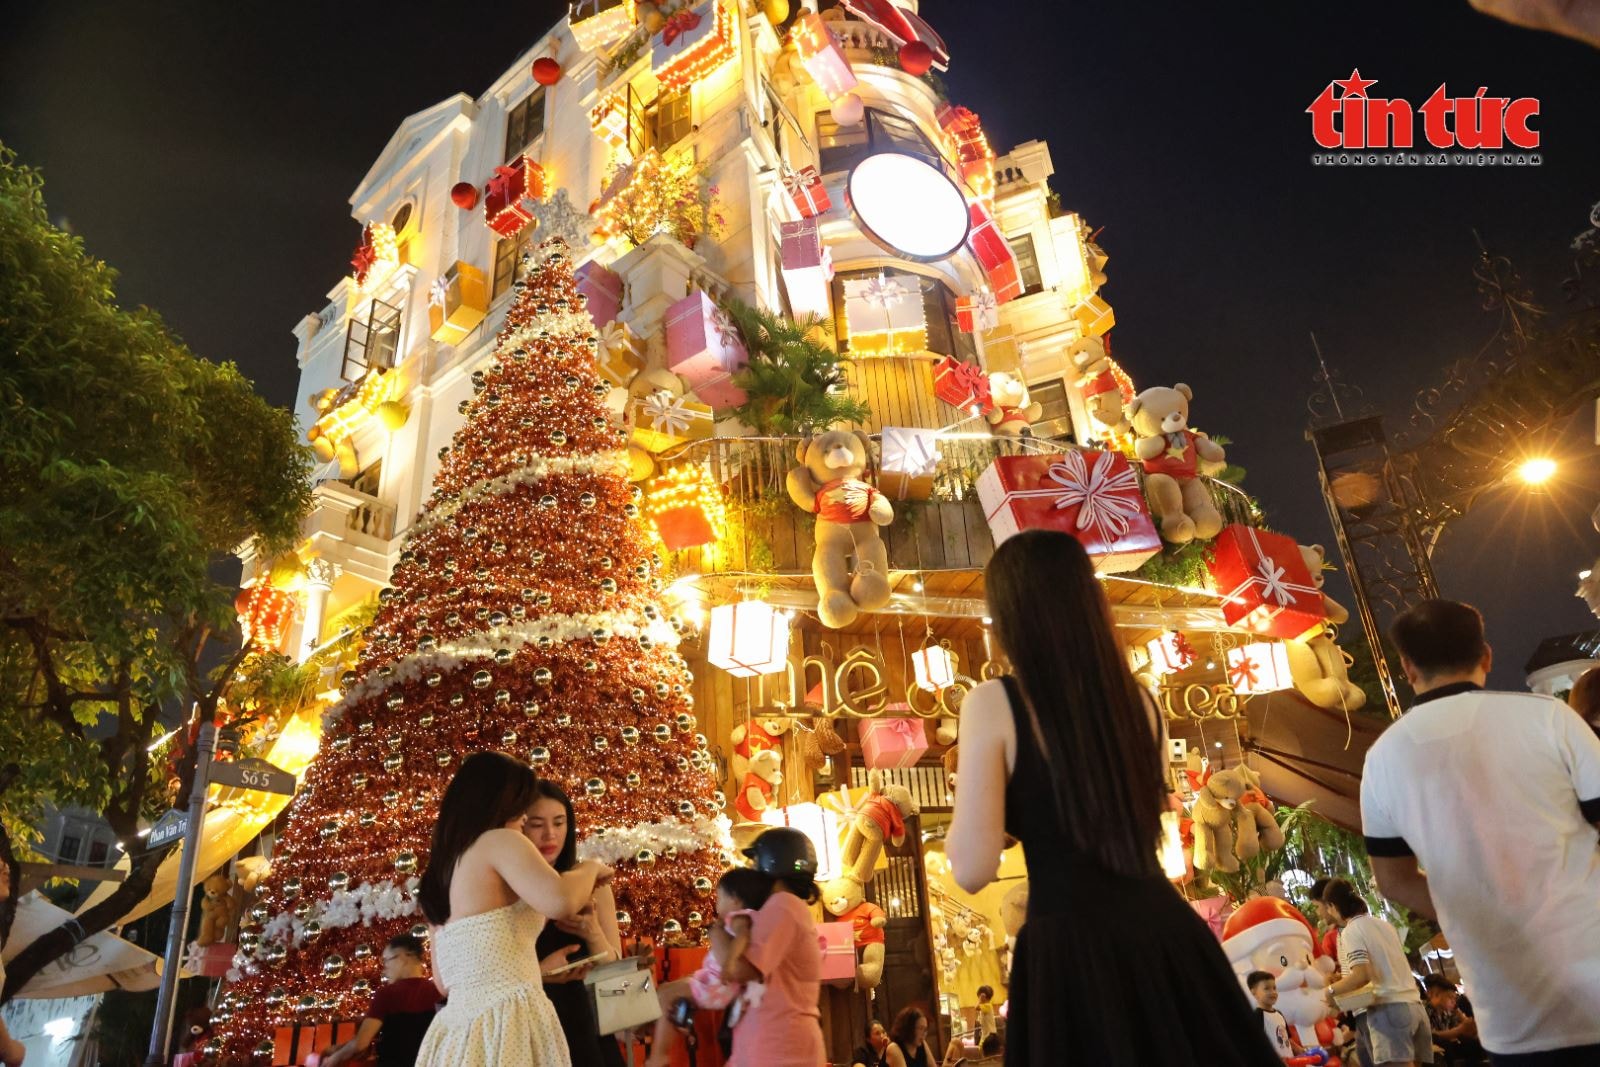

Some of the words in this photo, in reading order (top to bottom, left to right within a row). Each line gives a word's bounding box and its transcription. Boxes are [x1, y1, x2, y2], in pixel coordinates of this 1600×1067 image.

[1160, 672, 1240, 719] tea
[241, 769, 260, 786] Số
[260, 773, 270, 788] 5
[150, 829, 165, 844] Phan
[165, 824, 178, 838] Văn
